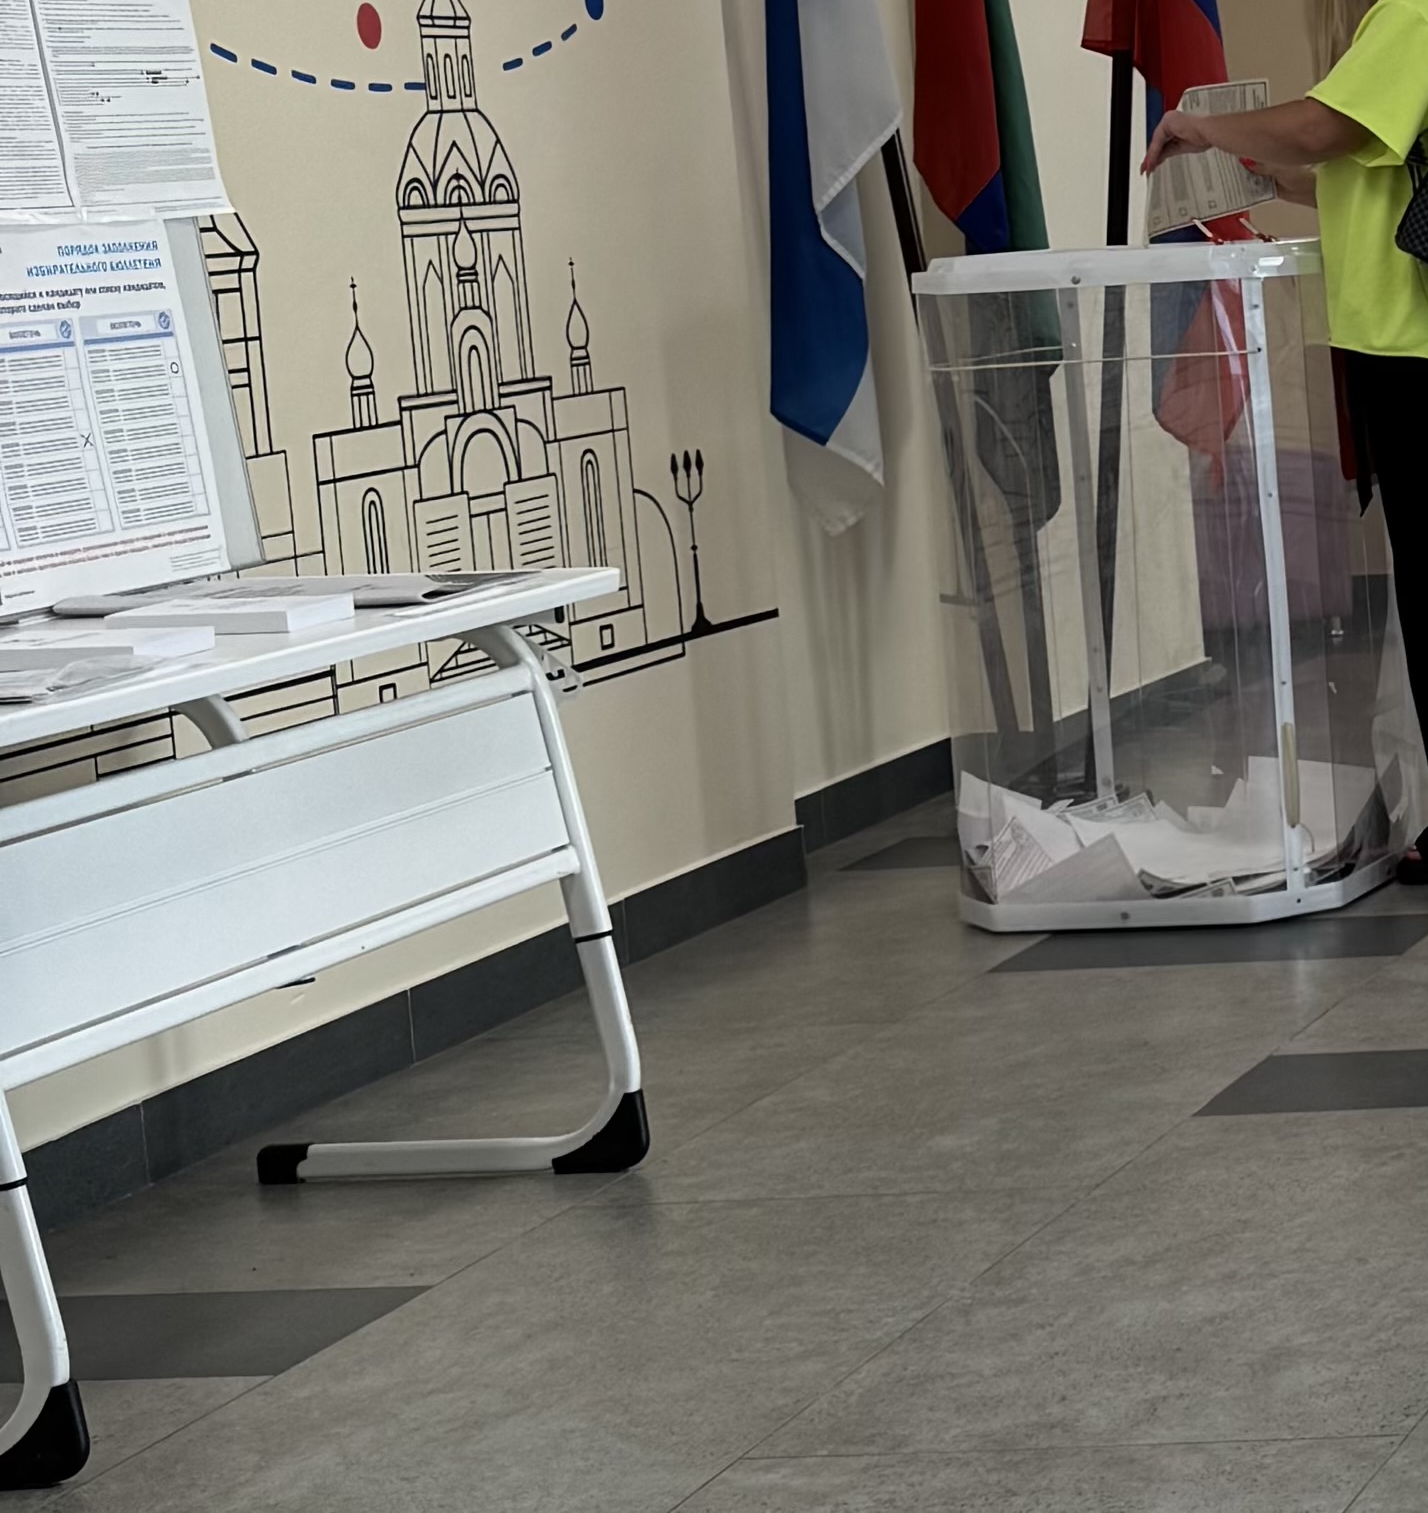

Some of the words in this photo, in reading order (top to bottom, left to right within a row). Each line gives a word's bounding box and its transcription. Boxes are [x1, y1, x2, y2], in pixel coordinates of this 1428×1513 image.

[57, 243, 100, 257] ПОРЯДОК
[102, 240, 158, 255] ЗАПОЛНЕНИЯ
[26, 261, 108, 277] ИЗБИРАТЕЛЬНОГО
[110, 258, 162, 271] БЮЛЛЕТЕНЯ
